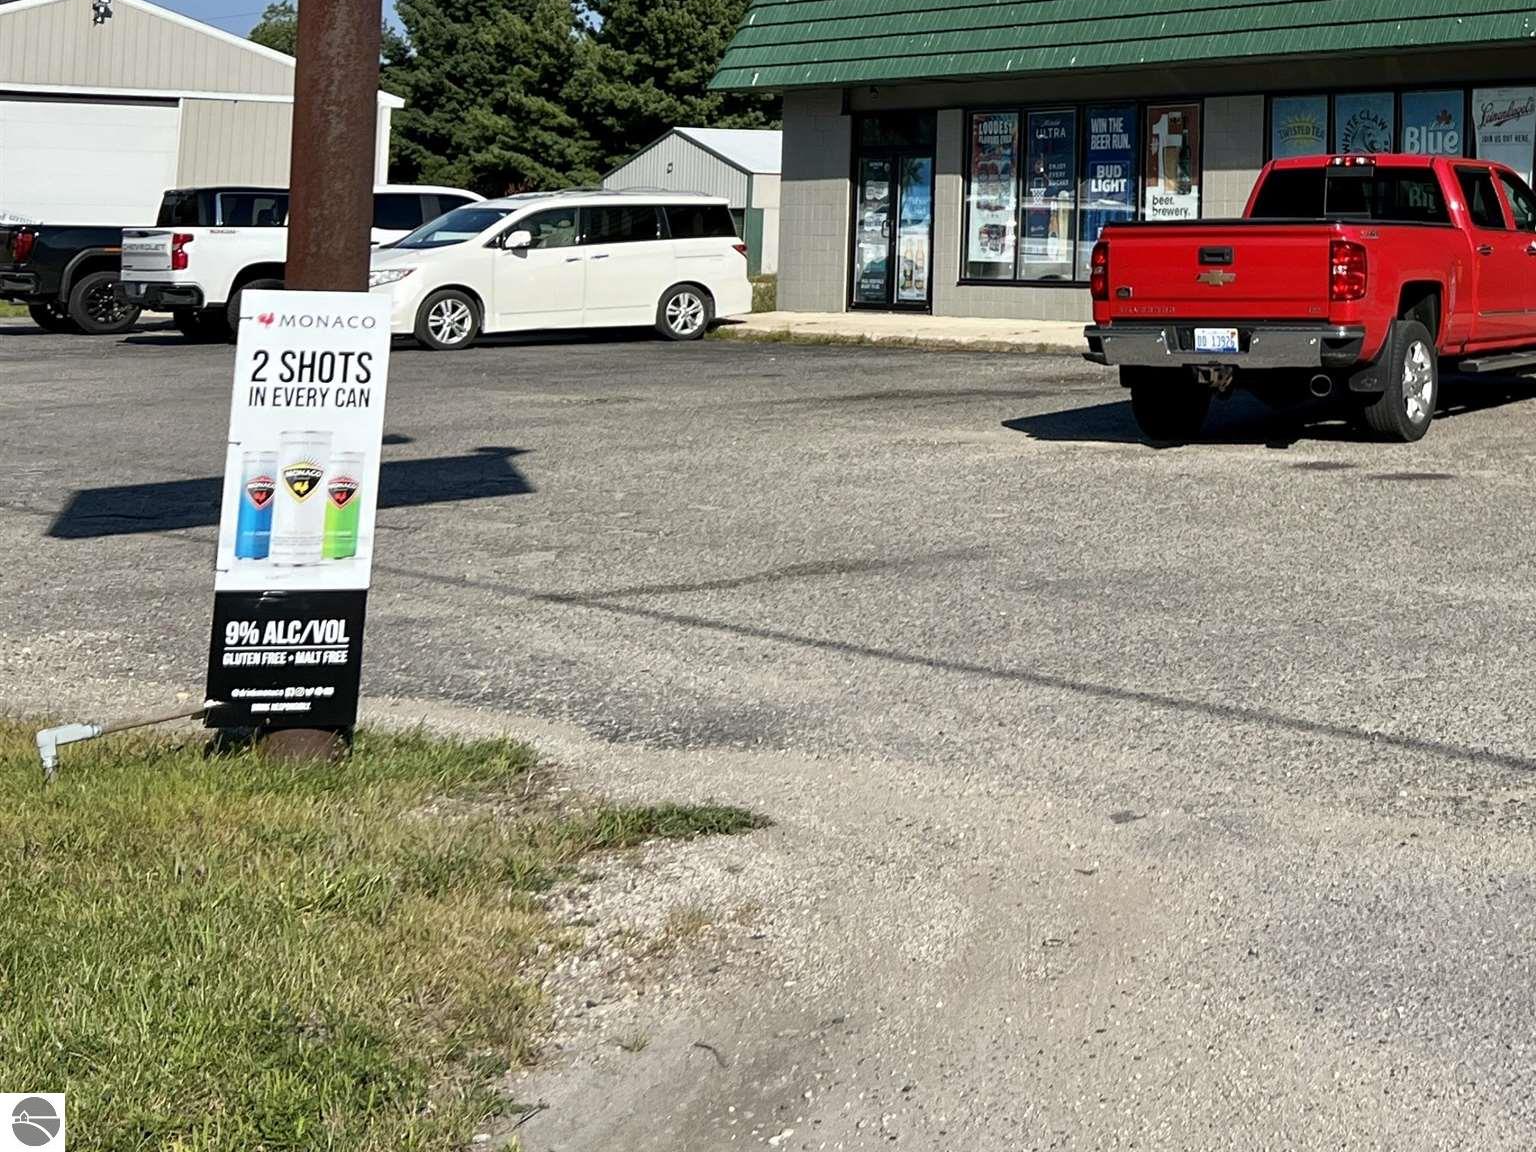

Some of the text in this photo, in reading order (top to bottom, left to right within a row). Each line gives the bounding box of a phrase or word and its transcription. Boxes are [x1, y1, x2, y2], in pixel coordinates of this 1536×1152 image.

[1091, 117, 1125, 133] WIN THE
[1359, 109, 1389, 132] CLAW
[1036, 128, 1066, 139] ULTRA
[1091, 133, 1131, 150] BEER RUN.
[1405, 126, 1459, 154] Blue
[1097, 165, 1122, 178] BUD
[1091, 179, 1127, 193] LIGHT
[1152, 195, 1174, 206] beer.
[1152, 206, 1191, 218] brewery.
[278, 314, 376, 329] MONACO
[251, 350, 373, 383] 2 SHOTS
[249, 386, 371, 407] IN EVERY CAN
[225, 619, 350, 645] 9% ALC/VOL
[222, 650, 348, 666] GLUTEN FREE MALT FREE
